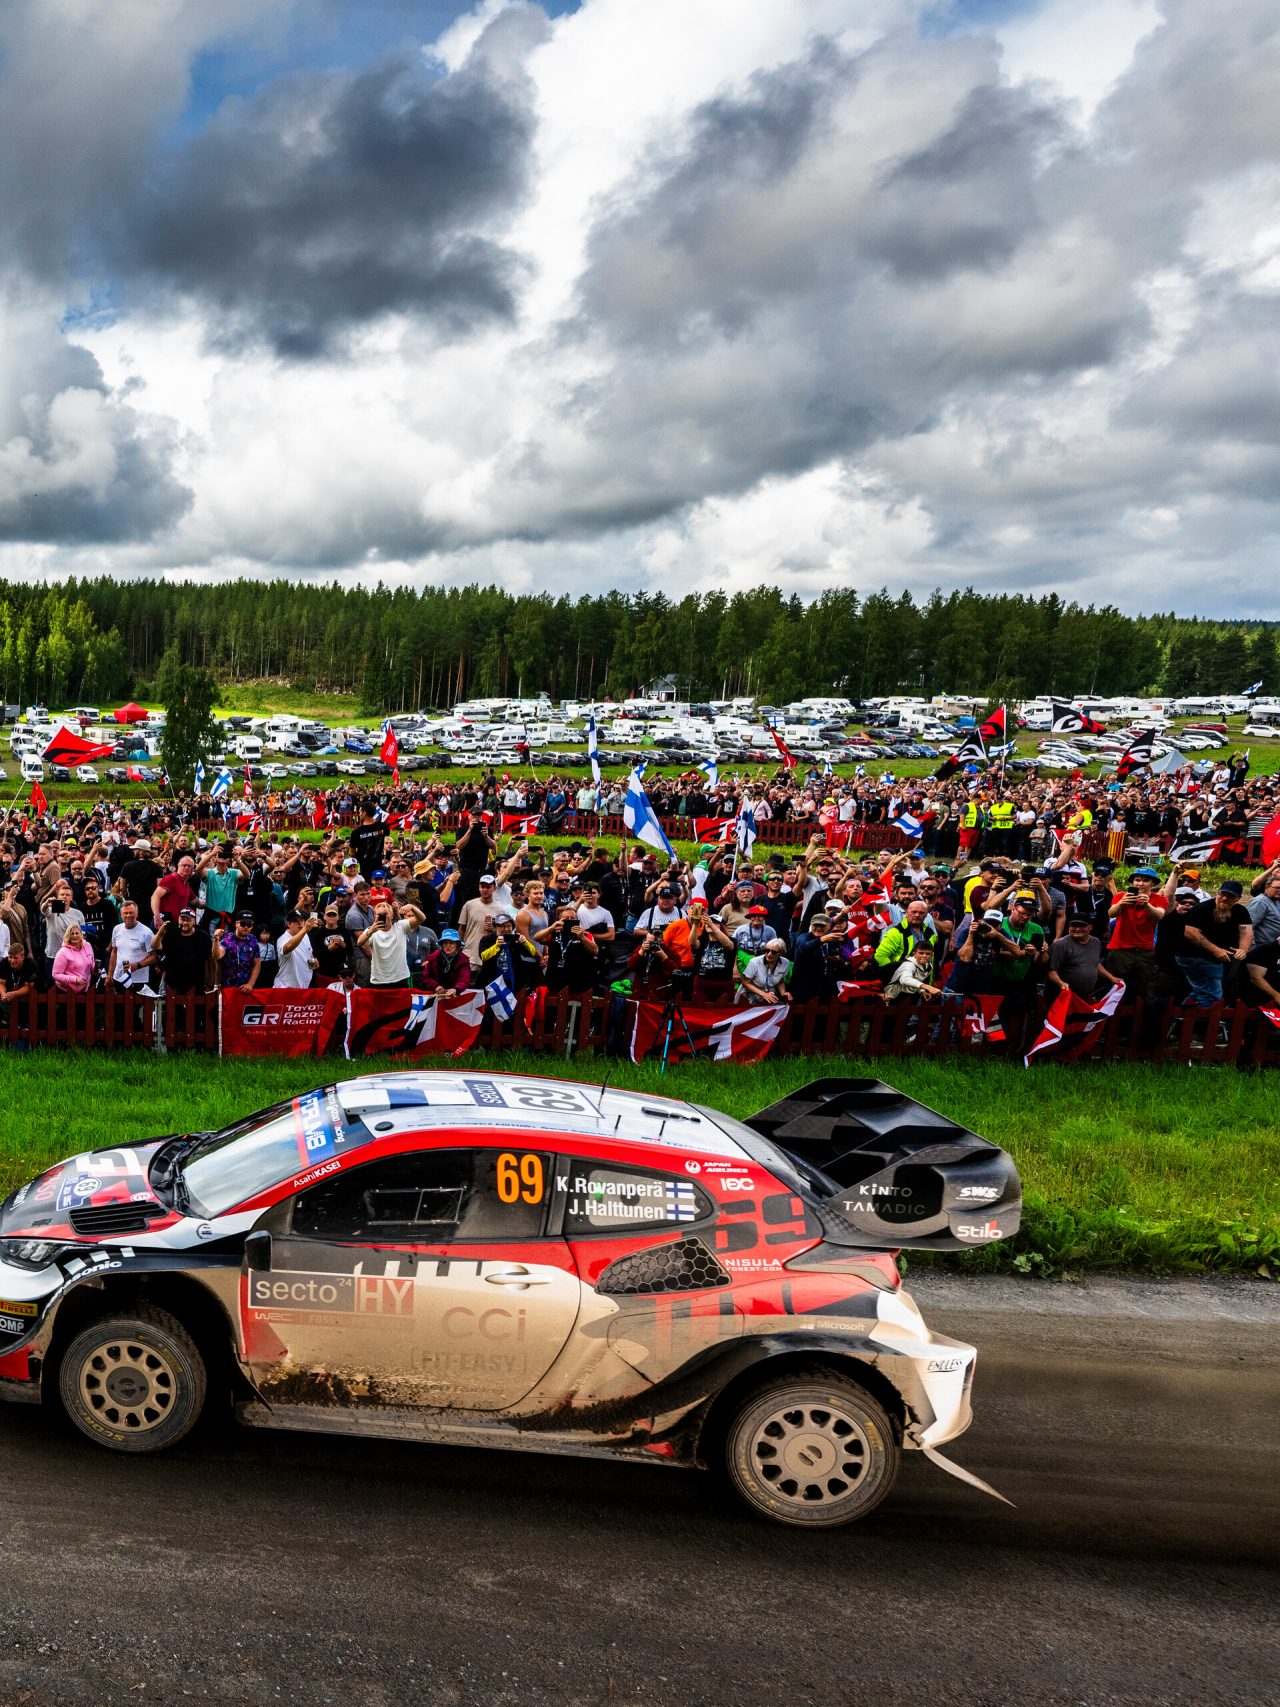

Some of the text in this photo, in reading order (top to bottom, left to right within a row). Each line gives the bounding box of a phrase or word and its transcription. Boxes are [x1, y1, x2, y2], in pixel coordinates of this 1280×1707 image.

[242, 1013, 280, 1025] GR
[472, 1084, 503, 1104] secto
[511, 1086, 585, 1112] 69
[496, 1153, 544, 1204] 69
[556, 1176, 663, 1199] K.Rovanperä
[568, 1199, 664, 1219] J.Halttunen
[843, 1200, 926, 1215] TAMADIC
[957, 1220, 1003, 1239] Stilo
[255, 1280, 337, 1303] secto
[359, 1279, 413, 1315] HY
[0, 1301, 35, 1314] PIRELLI
[0, 1318, 25, 1331] OMP
[817, 1320, 866, 1331] Microsoft
